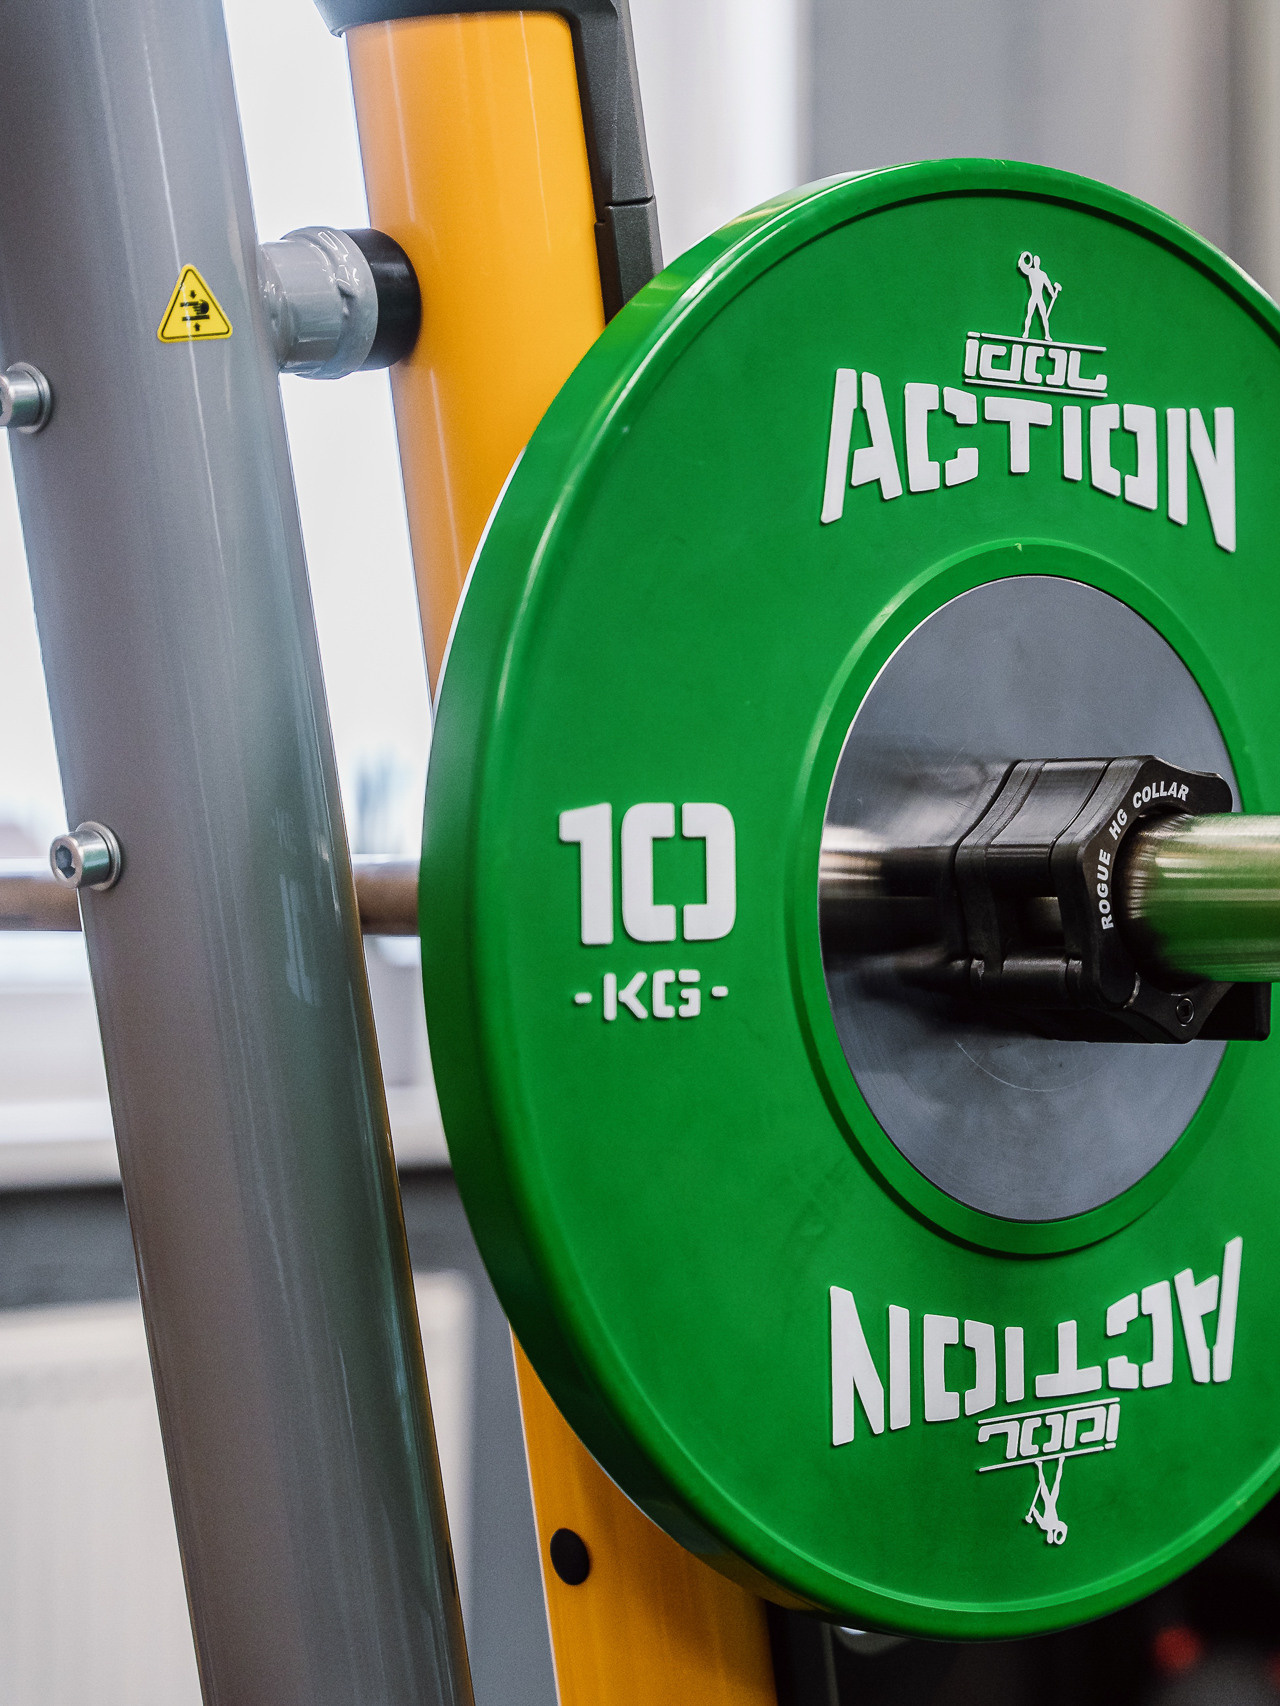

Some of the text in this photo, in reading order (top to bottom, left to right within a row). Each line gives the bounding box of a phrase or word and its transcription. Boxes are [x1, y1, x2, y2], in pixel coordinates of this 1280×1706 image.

[820, 367, 1237, 553] ACTION
[558, 802, 737, 945] 10
[1096, 780, 1189, 930] ROGUE HG COLLAR
[829, 1236, 1243, 1446] ACTION
